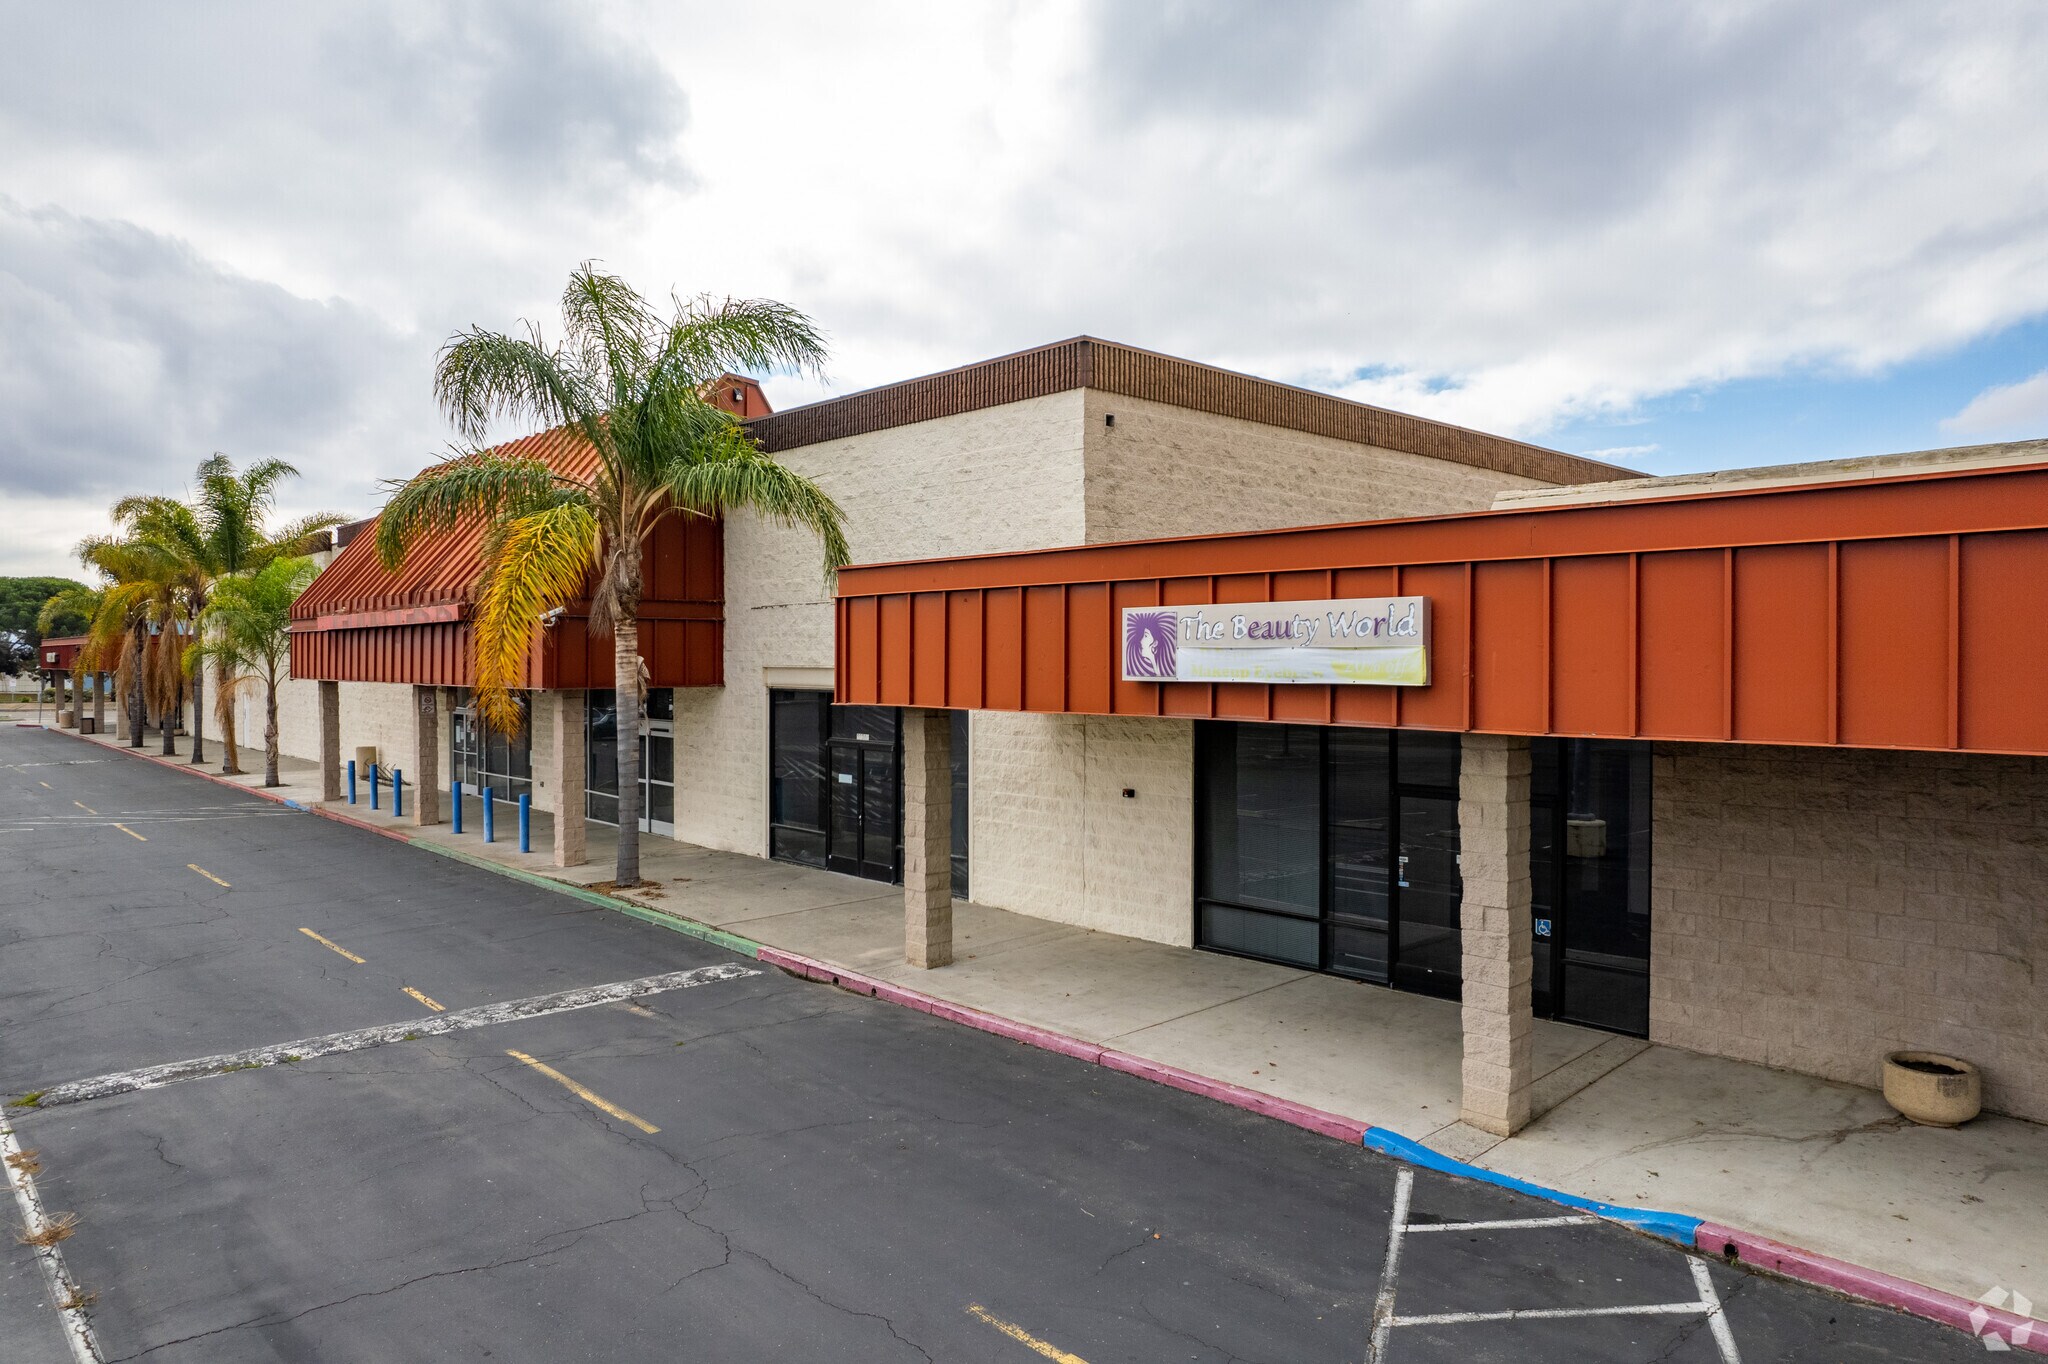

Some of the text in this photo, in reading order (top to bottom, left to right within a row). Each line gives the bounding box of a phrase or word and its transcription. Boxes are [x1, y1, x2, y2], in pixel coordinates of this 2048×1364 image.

[1180, 602, 1418, 647] The Beauty World
